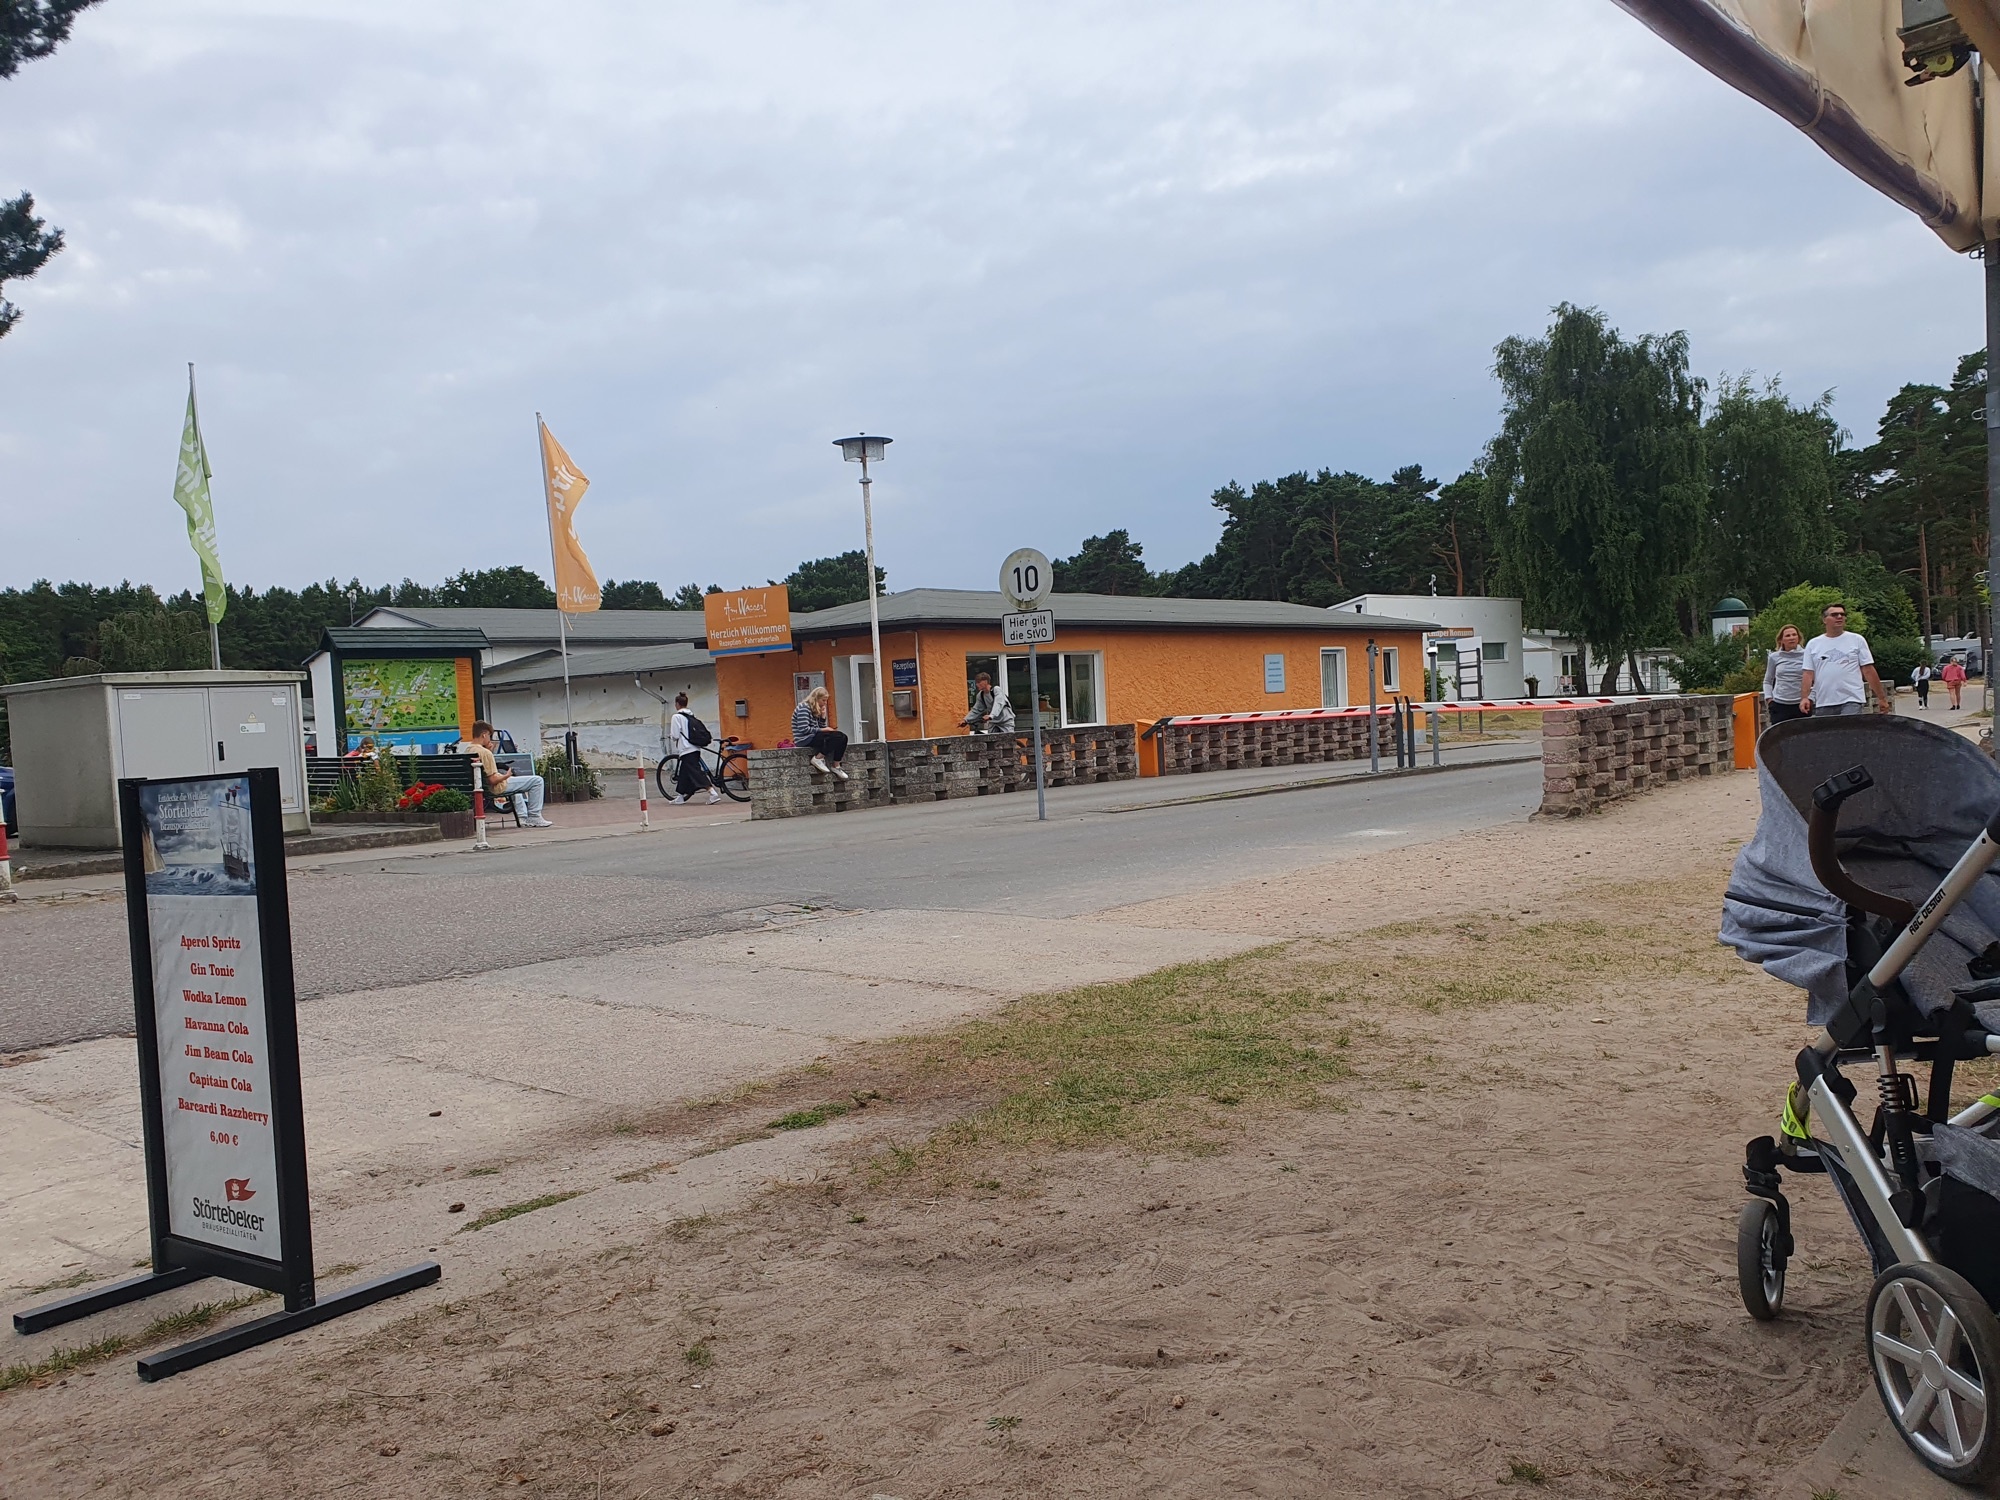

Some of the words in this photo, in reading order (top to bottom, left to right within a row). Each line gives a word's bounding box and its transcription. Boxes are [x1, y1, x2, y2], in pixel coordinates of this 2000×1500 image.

[1013, 565, 1039, 593] 10
[724, 599, 738, 622] Am
[1009, 617, 1029, 628] Hier
[1032, 615, 1047, 628] gilt
[710, 627, 739, 640] Herzlich
[740, 624, 787, 637] Willkommen
[1010, 631, 1024, 641] die
[1026, 628, 1048, 639] StVO
[719, 639, 742, 648] Rezeption
[744, 635, 780, 644] Fahrradverleih
[893, 661, 916, 671] Rezeption
[158, 802, 210, 819] Störtebeker
[1909, 916, 1924, 935] ABC
[1921, 888, 1946, 919] DESIGN
[180, 935, 210, 950] Aperol
[212, 935, 241, 952] Spritz
[190, 962, 207, 976] Gin
[209, 963, 235, 977] Tonic
[182, 989, 213, 1004] Wodka
[215, 992, 247, 1006] Lemon
[184, 1017, 225, 1033] Havanna
[227, 1021, 249, 1035] Cola
[184, 1044, 202, 1058] Jim
[203, 1046, 230, 1061] Beam
[232, 1049, 254, 1064] Cola
[189, 1072, 229, 1088] Capitain
[231, 1077, 253, 1092] Cola
[178, 1097, 218, 1115] Barcardi
[219, 1103, 269, 1126] Razzberry
[210, 1130, 230, 1145] 6,00
[232, 1134, 239, 1146] €
[193, 1197, 265, 1232] Störtebeker
[202, 1221, 257, 1241] BRAUSPEZIALITÄTEN
